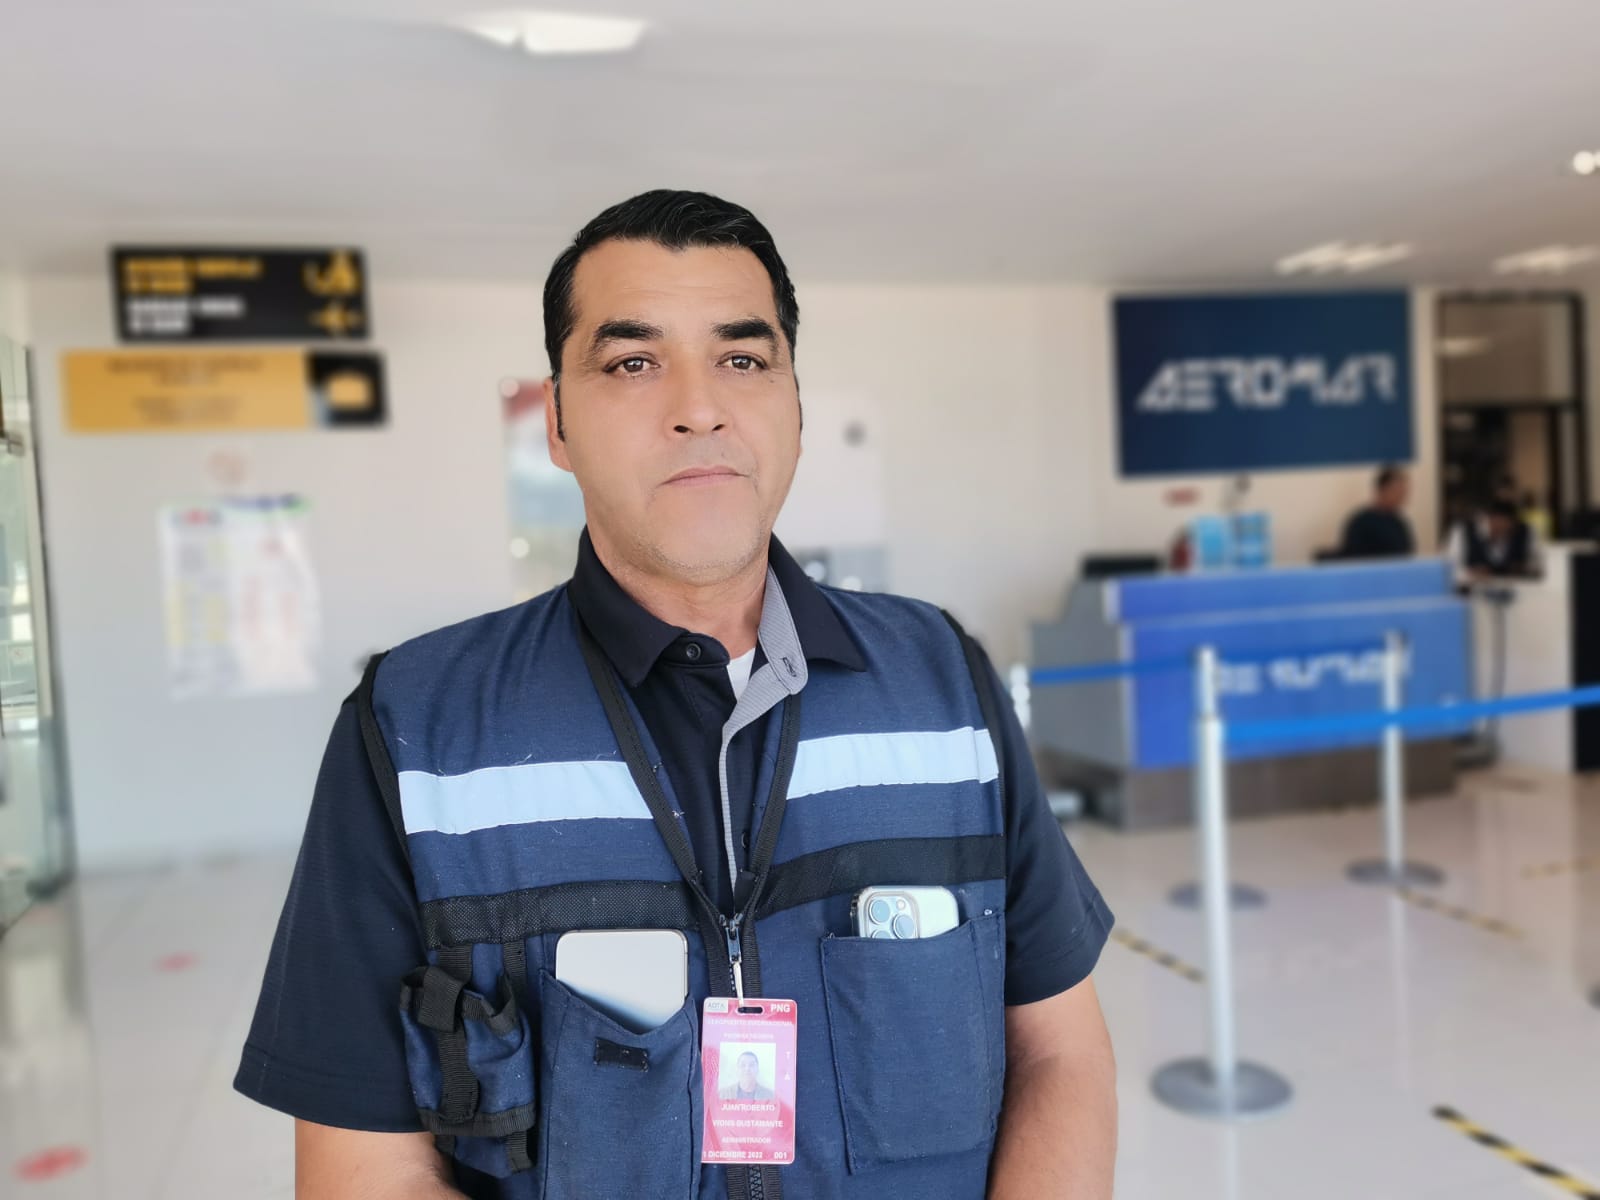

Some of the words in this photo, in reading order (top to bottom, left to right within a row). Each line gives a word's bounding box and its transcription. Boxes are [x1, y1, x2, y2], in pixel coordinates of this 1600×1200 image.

[770, 1003, 791, 1012] PNG
[740, 1104, 775, 1112] ROBERTO
[708, 1151, 746, 1159] DICIEMBRE
[774, 1152, 787, 1160] 001
